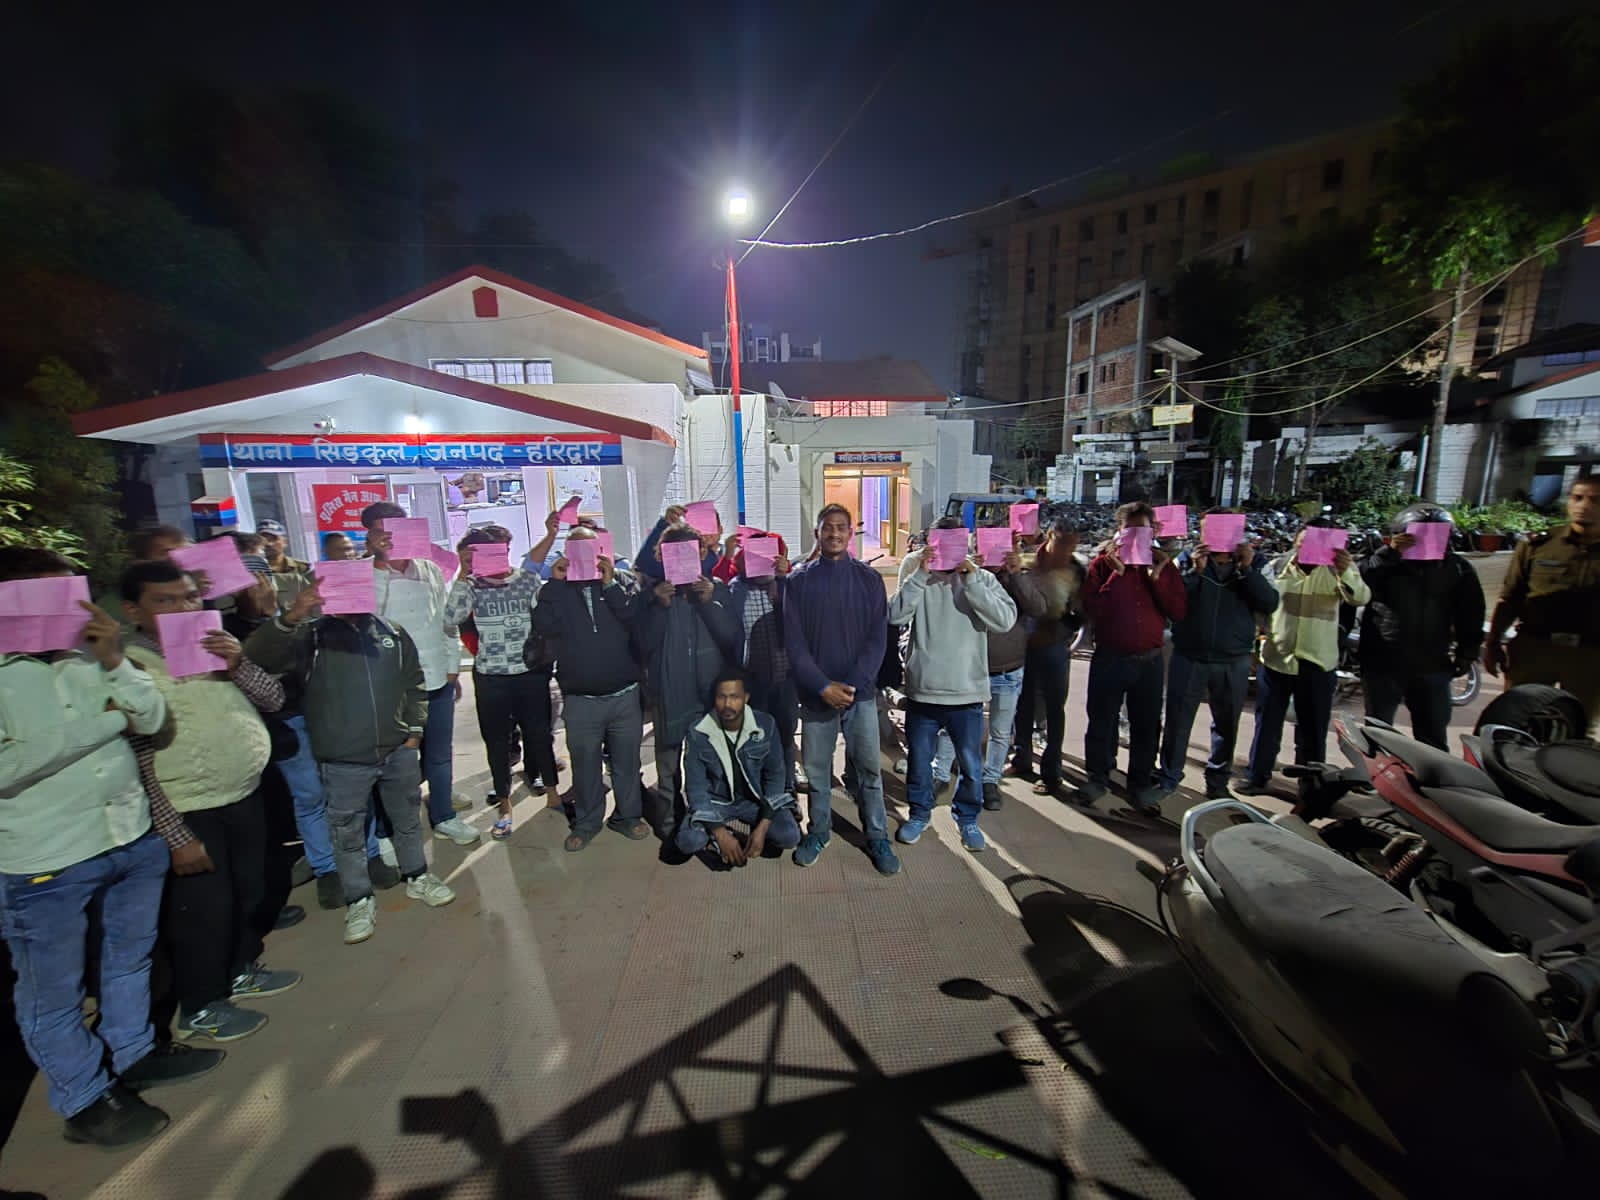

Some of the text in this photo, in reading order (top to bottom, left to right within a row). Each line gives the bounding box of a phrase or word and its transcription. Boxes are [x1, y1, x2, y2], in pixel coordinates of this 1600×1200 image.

[231, 442, 293, 461] थाना
[425, 442, 504, 463] जनपद
[486, 598, 529, 617] GUCC
